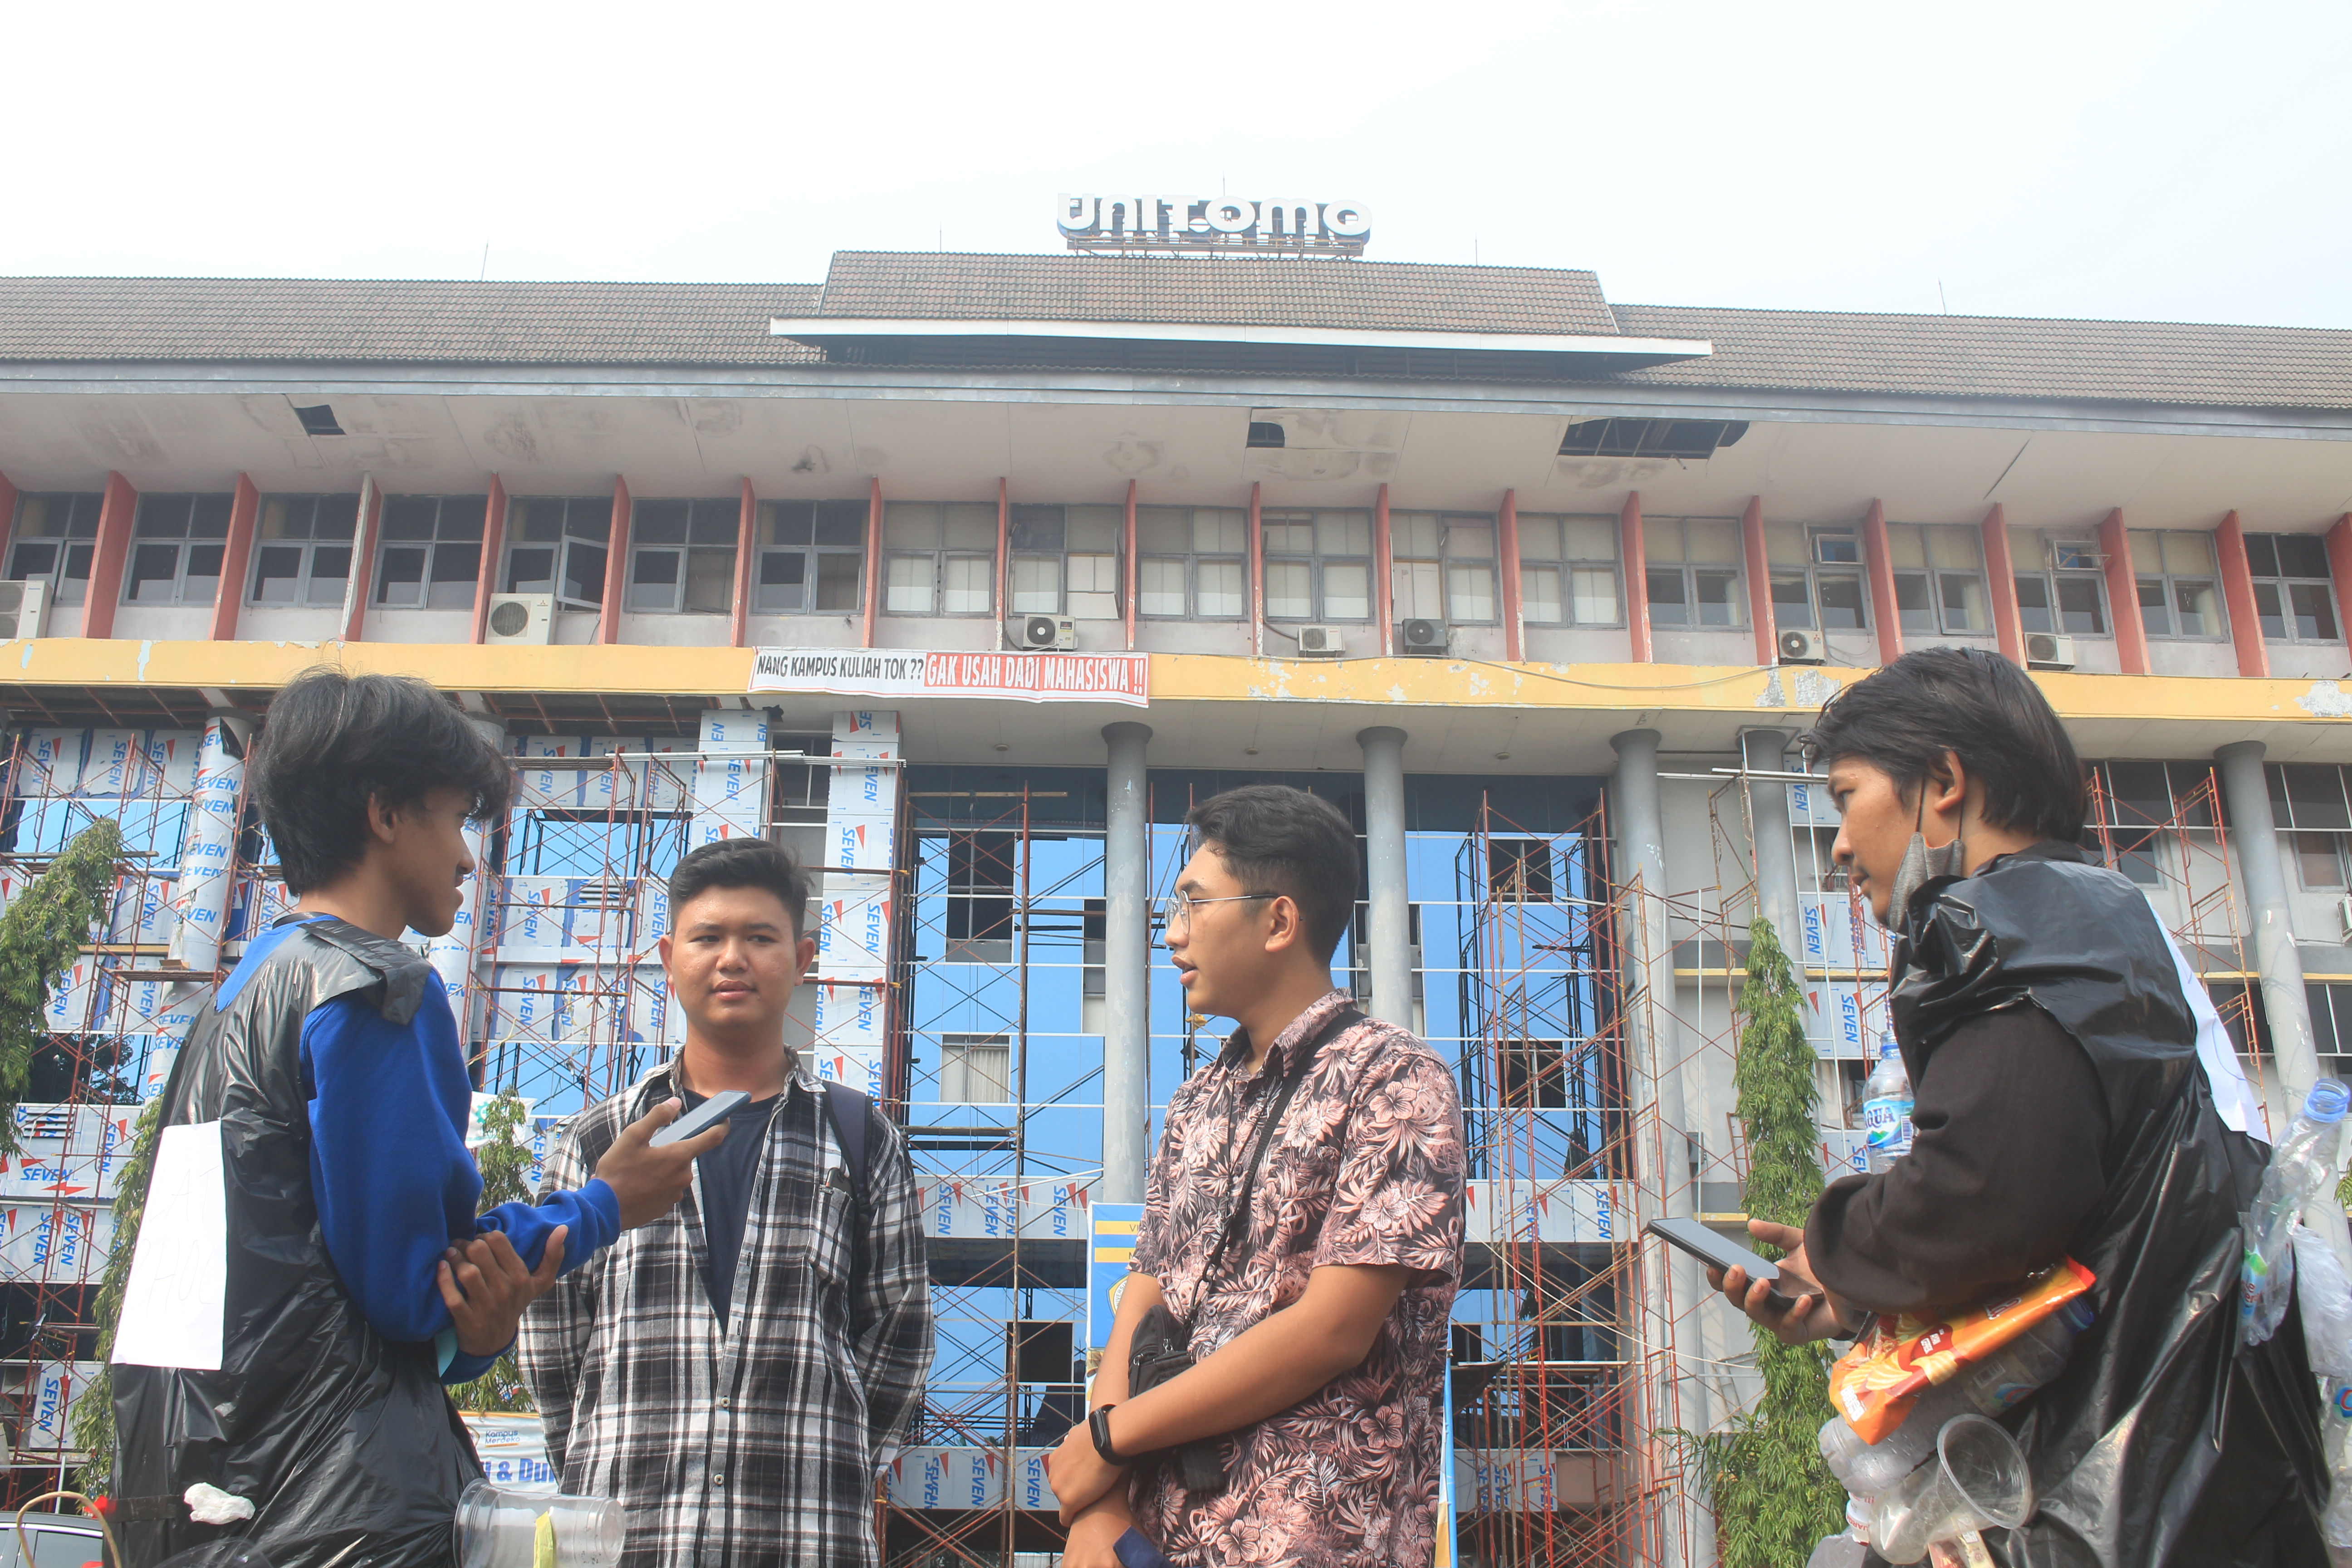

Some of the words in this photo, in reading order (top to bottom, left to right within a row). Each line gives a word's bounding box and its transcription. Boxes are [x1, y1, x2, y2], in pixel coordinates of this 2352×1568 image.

[756, 656, 788, 677] NANG
[790, 656, 838, 677] KAMPUS
[839, 657, 882, 679] KULIAH
[884, 658, 908, 680] TOK
[910, 658, 924, 680] ??
[927, 654, 958, 686] GAK
[961, 655, 1001, 686] USAH
[1004, 656, 1040, 690] DADI
[1044, 657, 1129, 691] MAHASISWA
[108, 740, 127, 786] SEVEN
[202, 734, 222, 748] SEV
[726, 759, 741, 801] EVEN
[1791, 766, 1808, 811] SVEN
[141, 882, 160, 931] SEVEN
[259, 885, 278, 932] SEVEN
[651, 892, 666, 940] SEVEN
[819, 903, 833, 952] SEVEN
[866, 903, 881, 953] SEVEN
[1804, 906, 1821, 954] SEVEN
[140, 980, 156, 1018] EVEN
[1841, 994, 1858, 1043] SEVEN
[154, 1037, 184, 1050] SEVE
[1865, 1107, 1896, 1128] QUA
[20, 1168, 73, 1181] SEVEN
[530, 1132, 546, 1182] SEVEN
[937, 1184, 952, 1235] SEVEN
[985, 1184, 999, 1236] SEVEN
[1053, 1185, 1067, 1237] SEVEN
[1595, 1190, 1612, 1240] SEVEN
[33, 1212, 53, 1265] SEVEN
[61, 1214, 80, 1266] SEVEN
[38, 1377, 59, 1433] SEVEN
[971, 1455, 985, 1507] SEVEN
[1027, 1458, 1041, 1508] SEVEN
